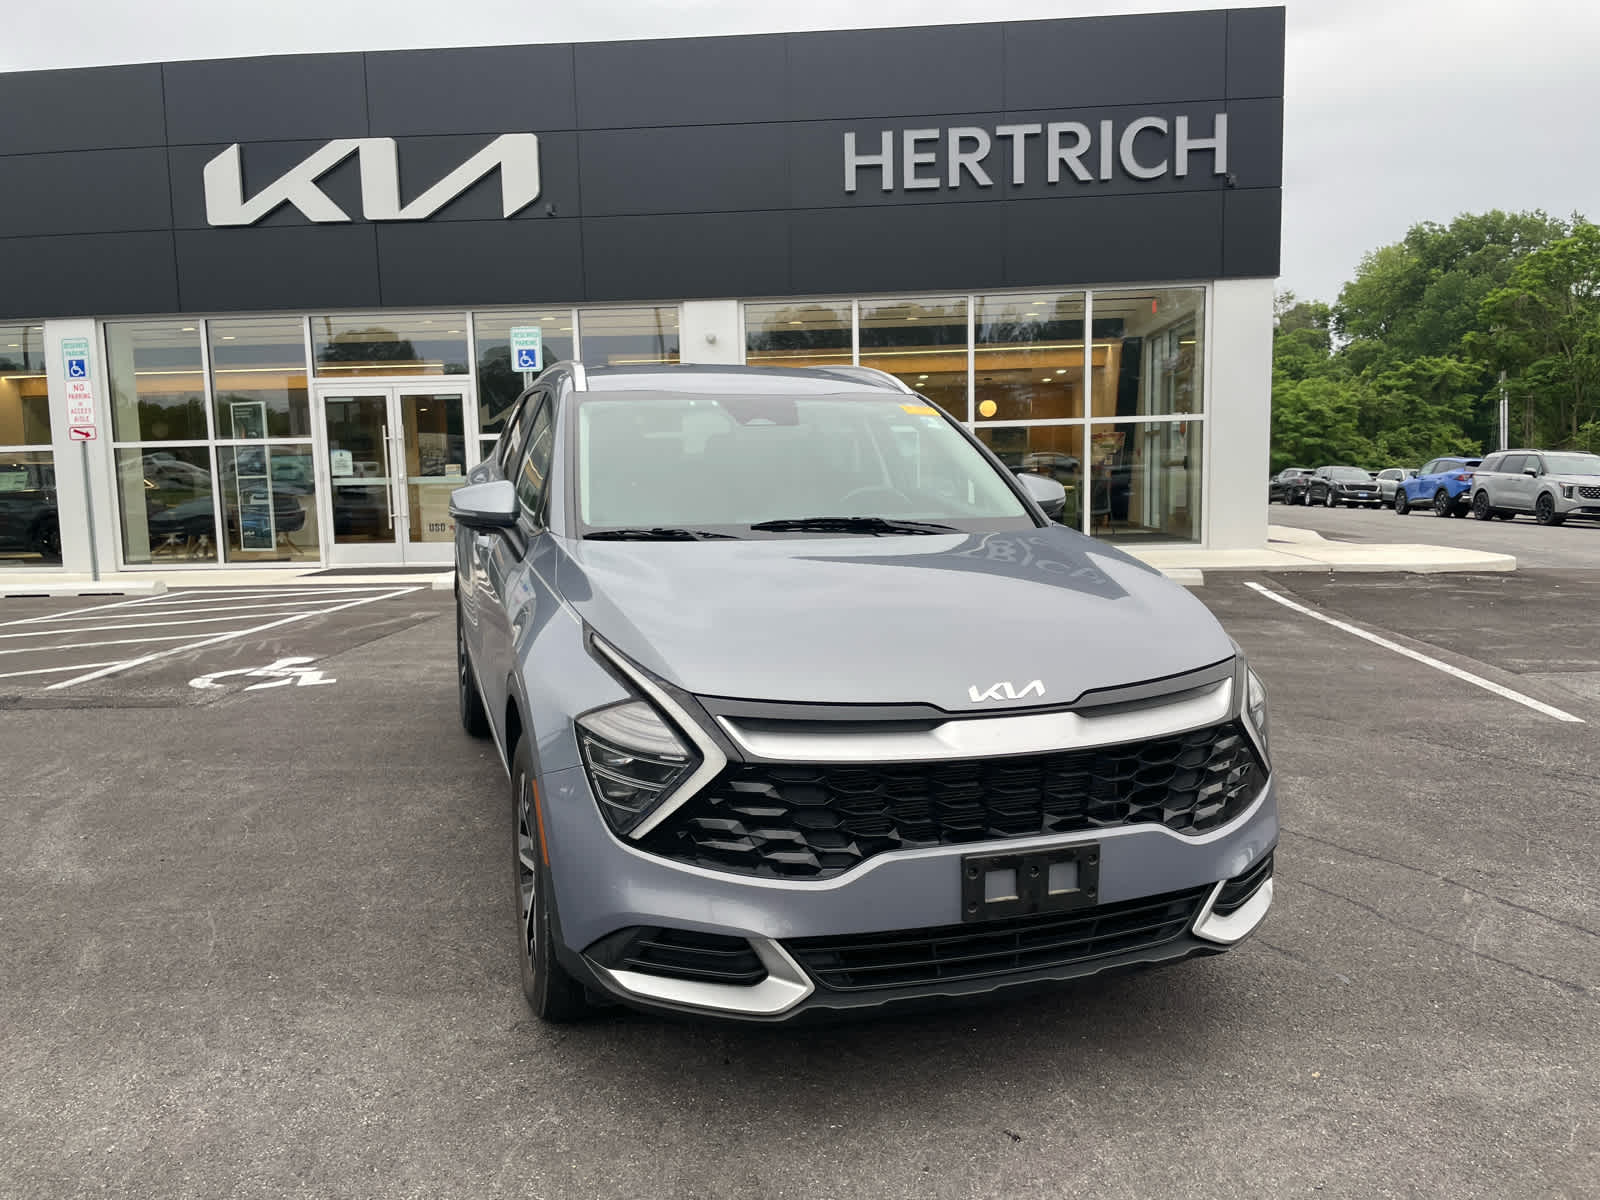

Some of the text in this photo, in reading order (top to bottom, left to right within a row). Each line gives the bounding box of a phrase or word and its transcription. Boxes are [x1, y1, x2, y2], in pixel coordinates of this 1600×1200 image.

[843, 113, 1228, 192] HERTRICH
[203, 133, 541, 226] KIA
[73, 383, 85, 392] NO
[968, 679, 1046, 703] KIA
